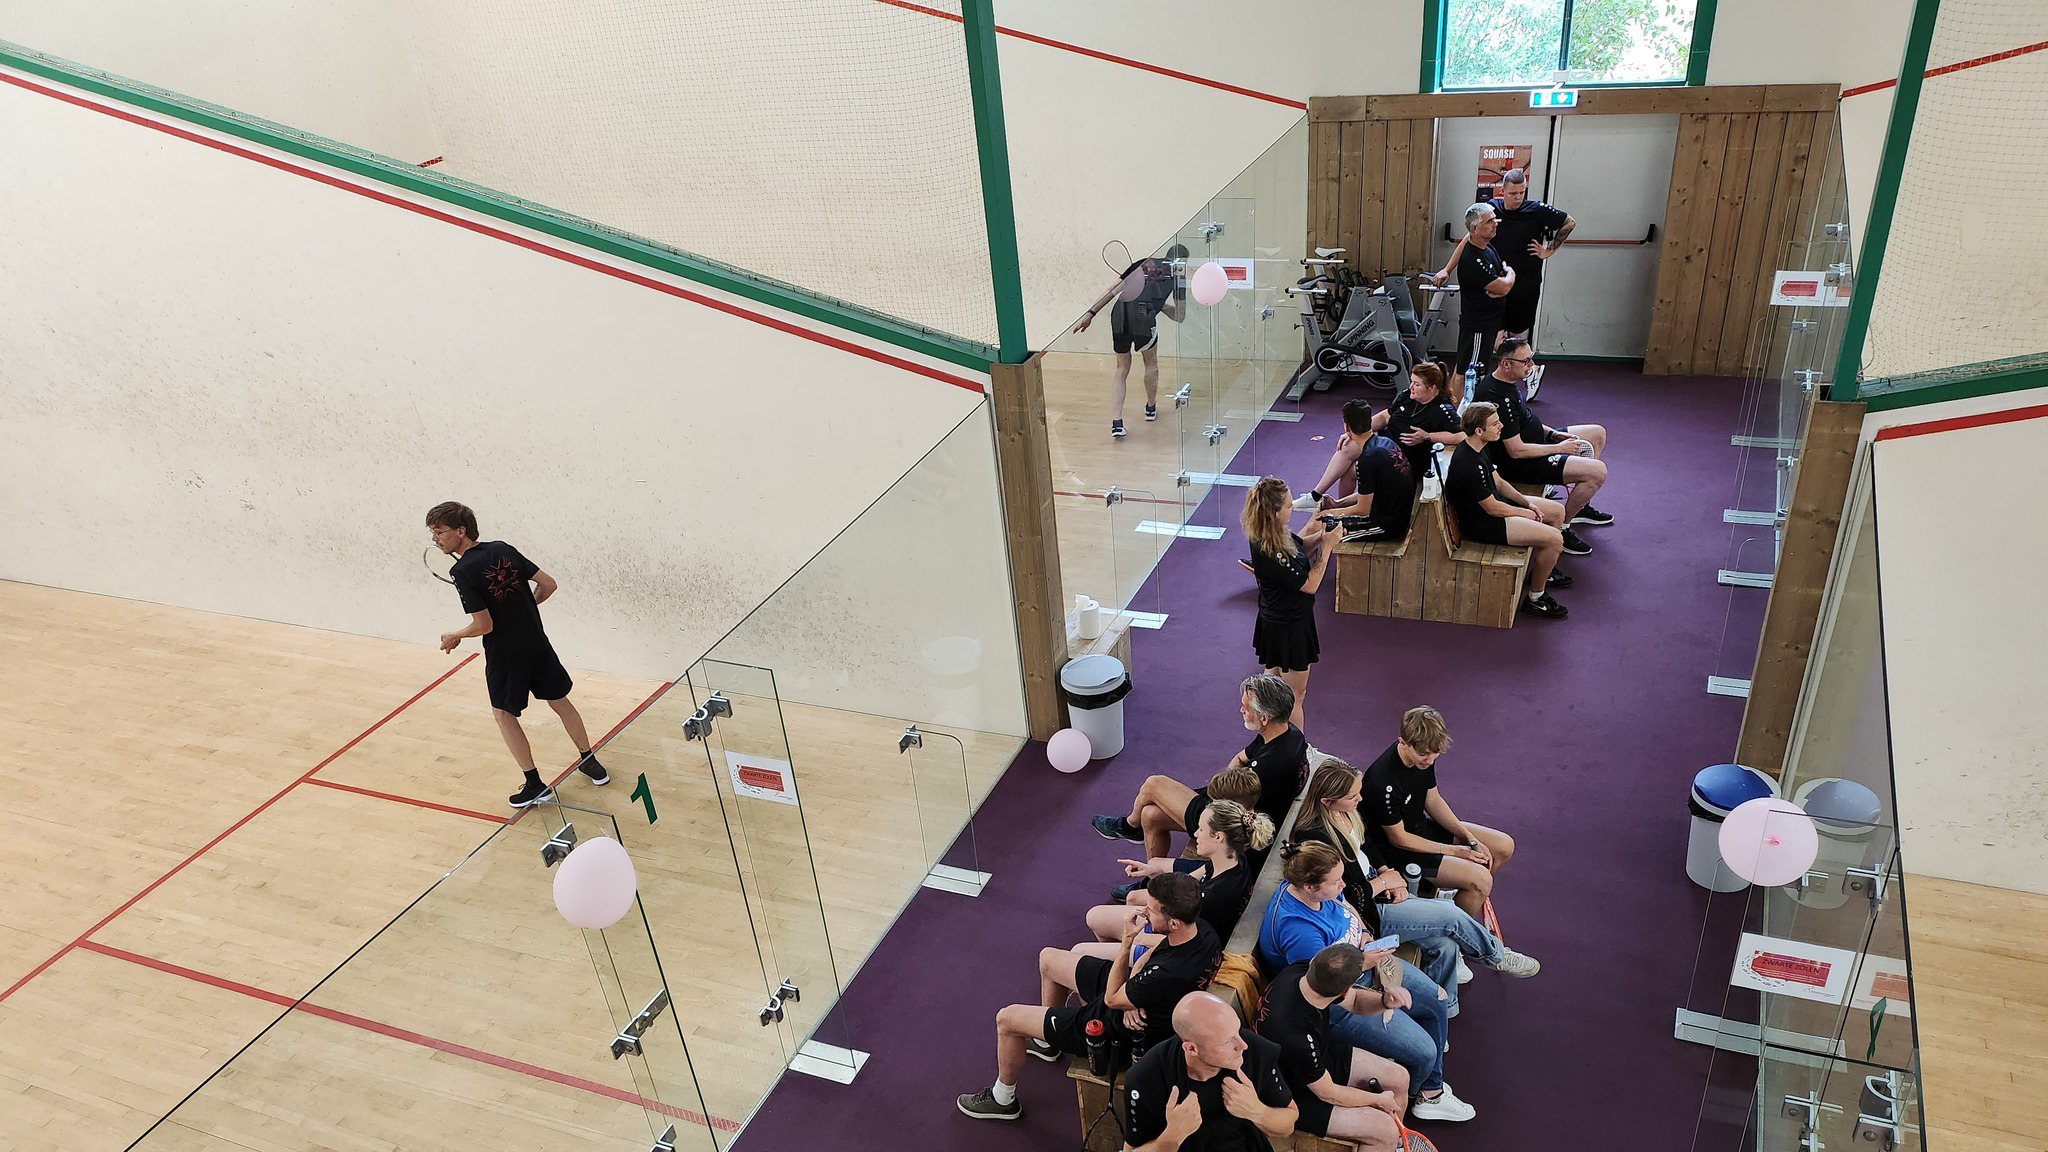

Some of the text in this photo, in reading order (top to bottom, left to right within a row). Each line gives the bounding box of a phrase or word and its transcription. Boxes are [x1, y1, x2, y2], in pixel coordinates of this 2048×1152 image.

[1483, 149, 1514, 159] SQUASH
[1347, 319, 1375, 346] SPINNING
[630, 771, 658, 825] 1
[1762, 960, 1820, 974] ZWARTE ZOLEN
